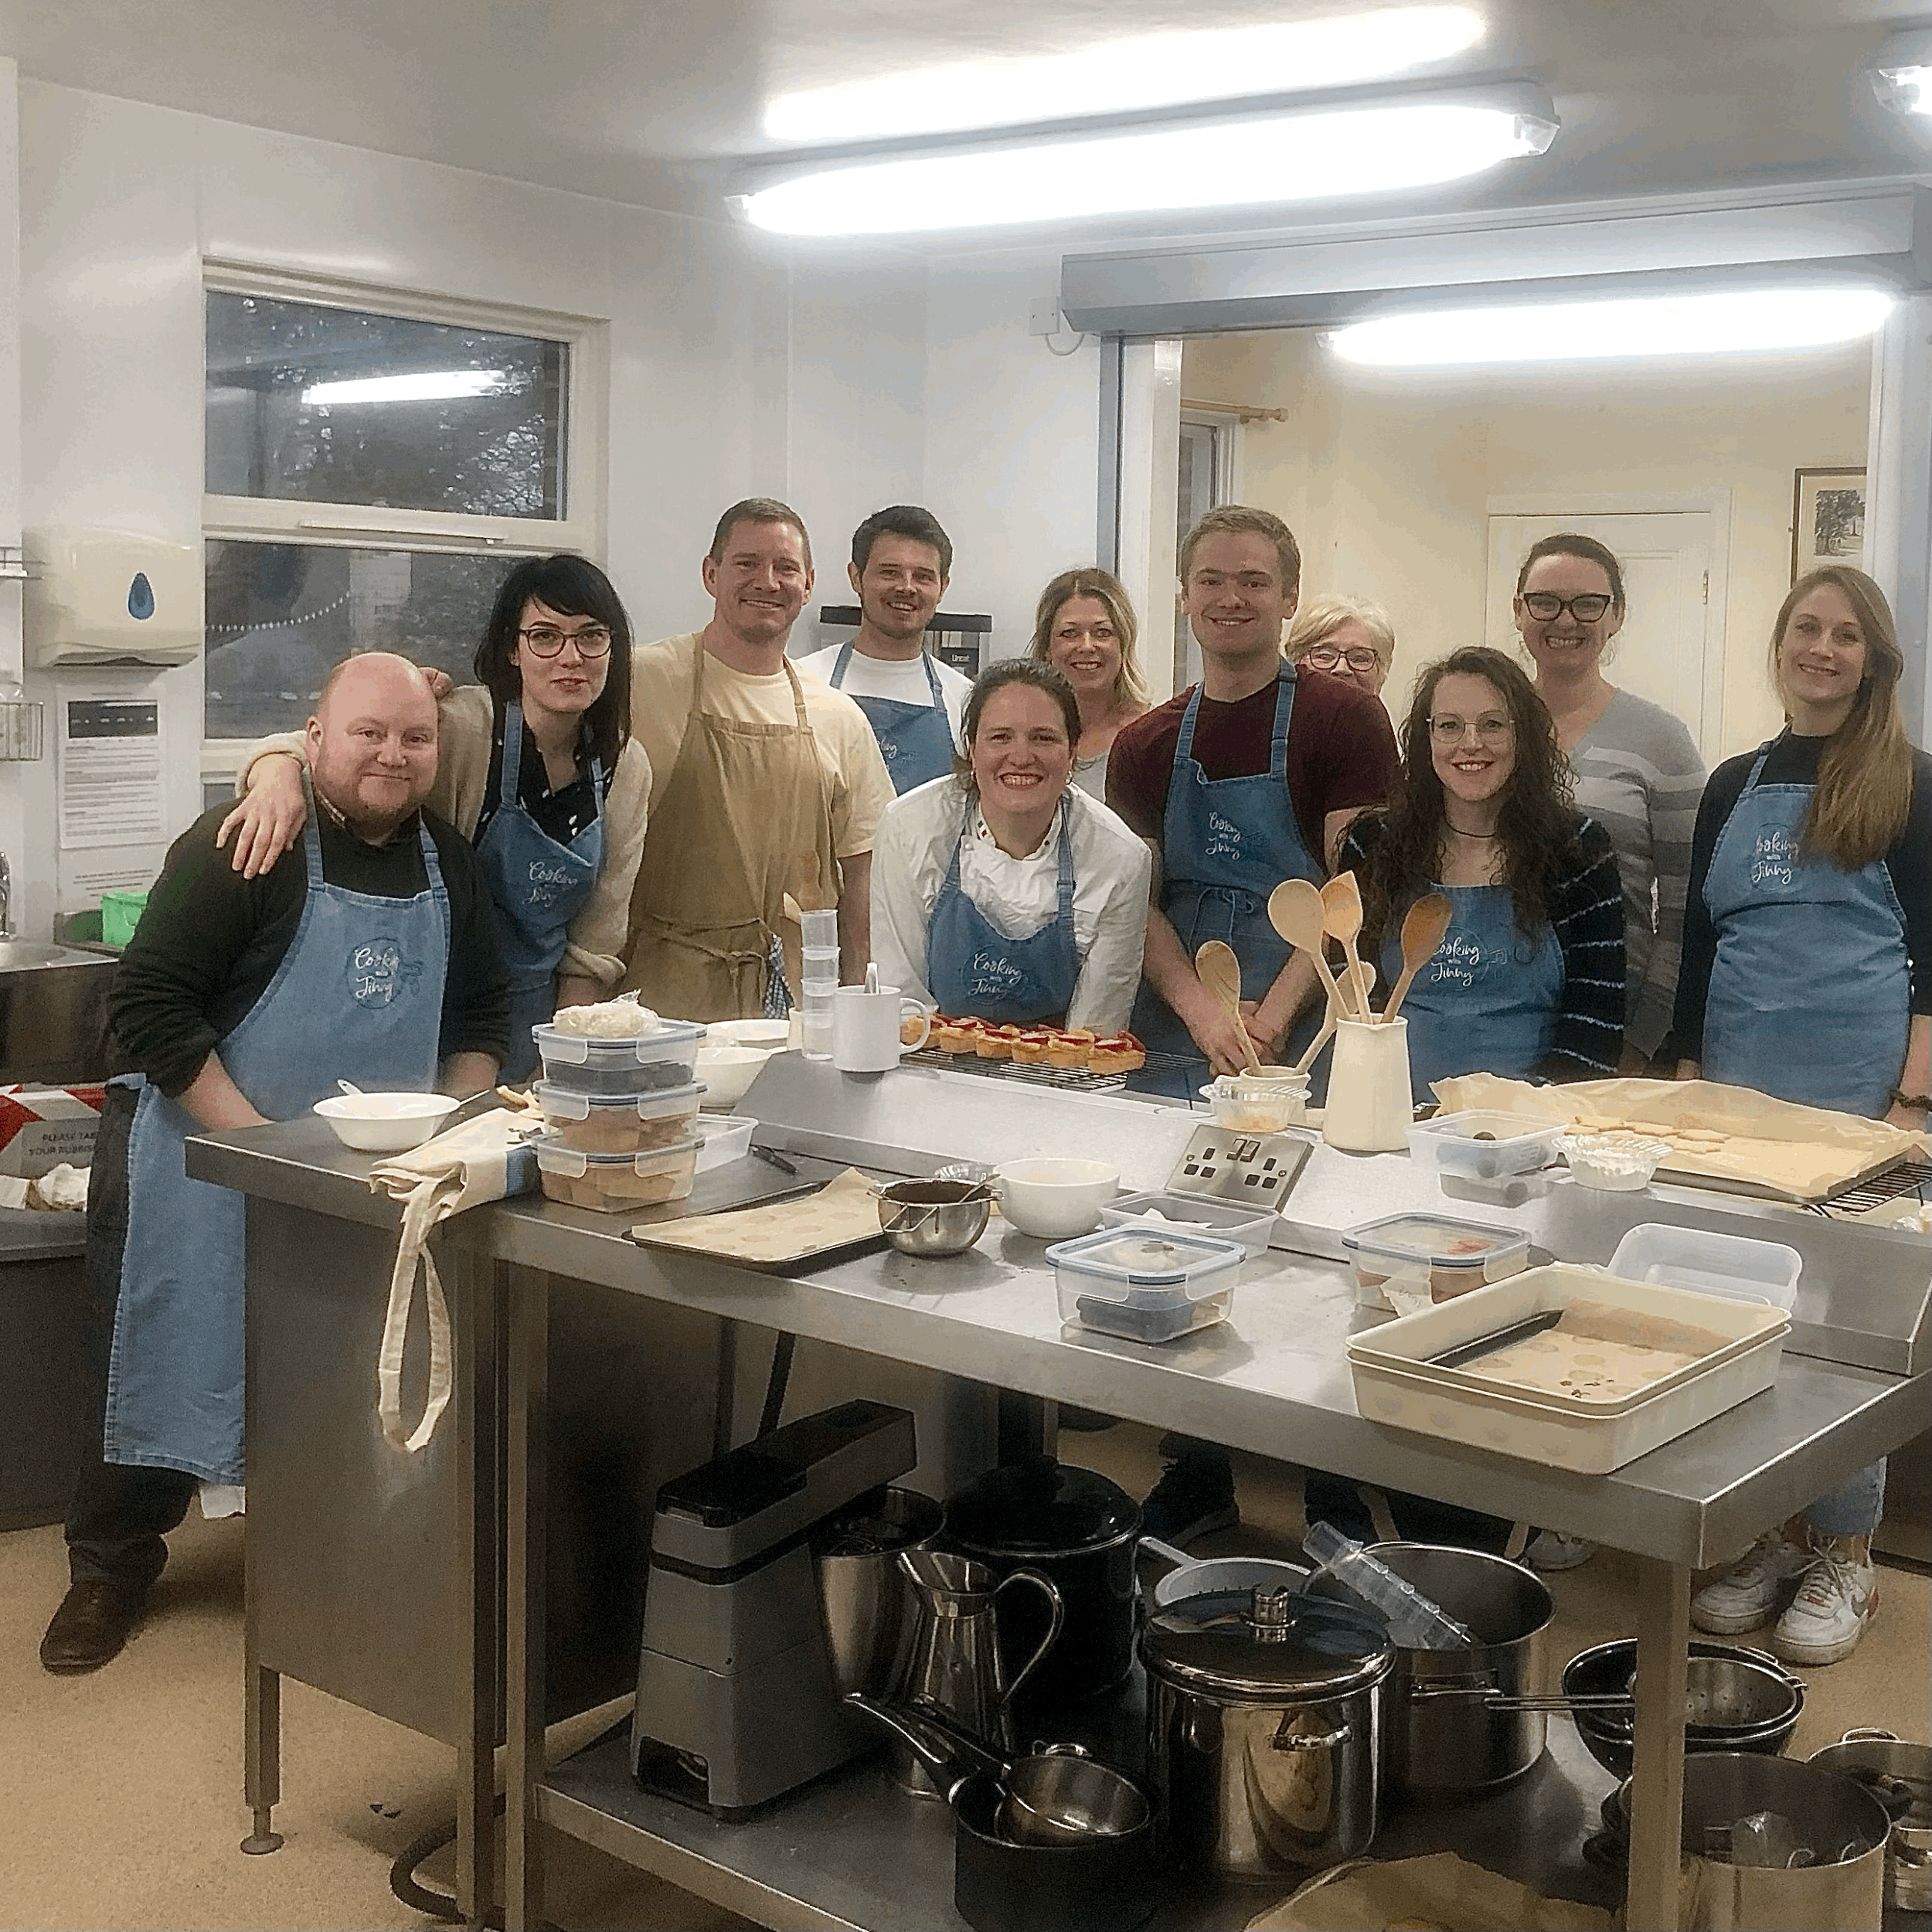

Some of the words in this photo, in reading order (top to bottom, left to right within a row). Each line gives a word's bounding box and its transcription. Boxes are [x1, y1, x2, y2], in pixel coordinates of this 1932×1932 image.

[973, 952, 1022, 985] Cooking
[1430, 961, 1475, 987] Jinny
[79, 1131, 97, 1140] TAK
[57, 1145, 93, 1155] RUBBIS
